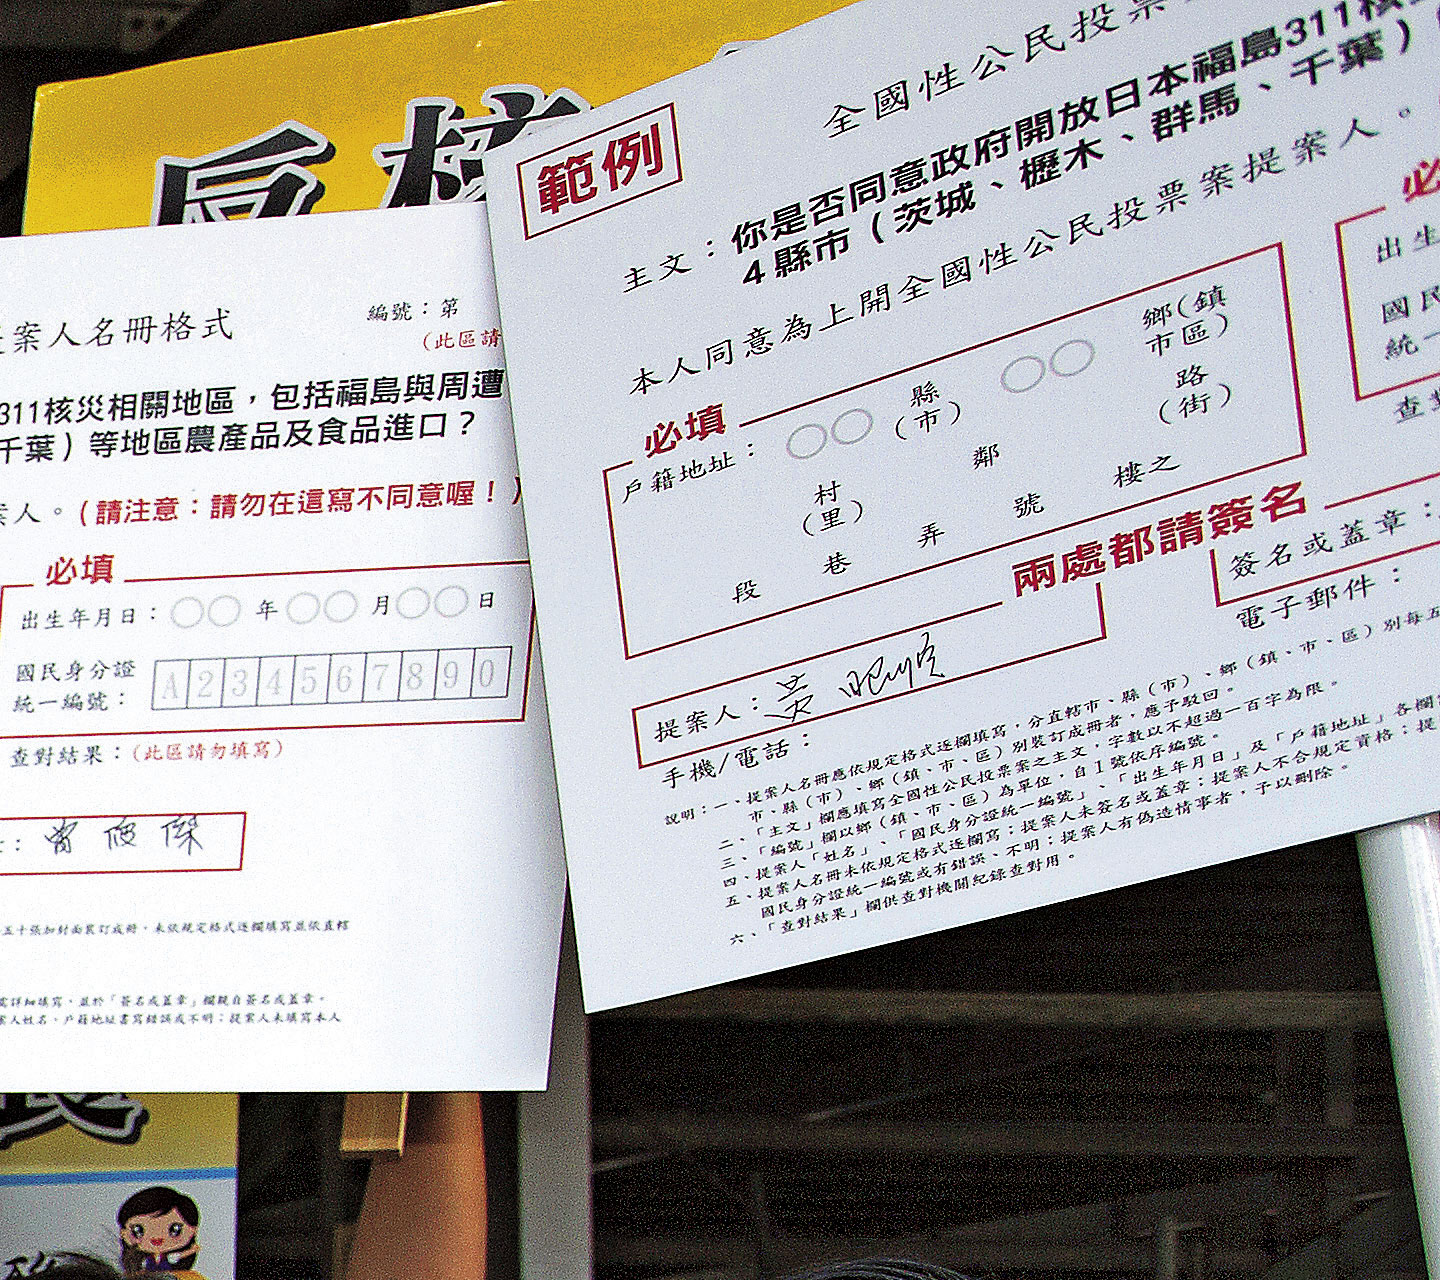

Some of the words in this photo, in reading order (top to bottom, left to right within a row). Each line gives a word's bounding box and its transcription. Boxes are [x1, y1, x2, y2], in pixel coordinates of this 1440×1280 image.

[535, 122, 665, 221] 範例
[642, 401, 727, 460] 必填
[1012, 478, 1306, 598] 兩處都請簽名
